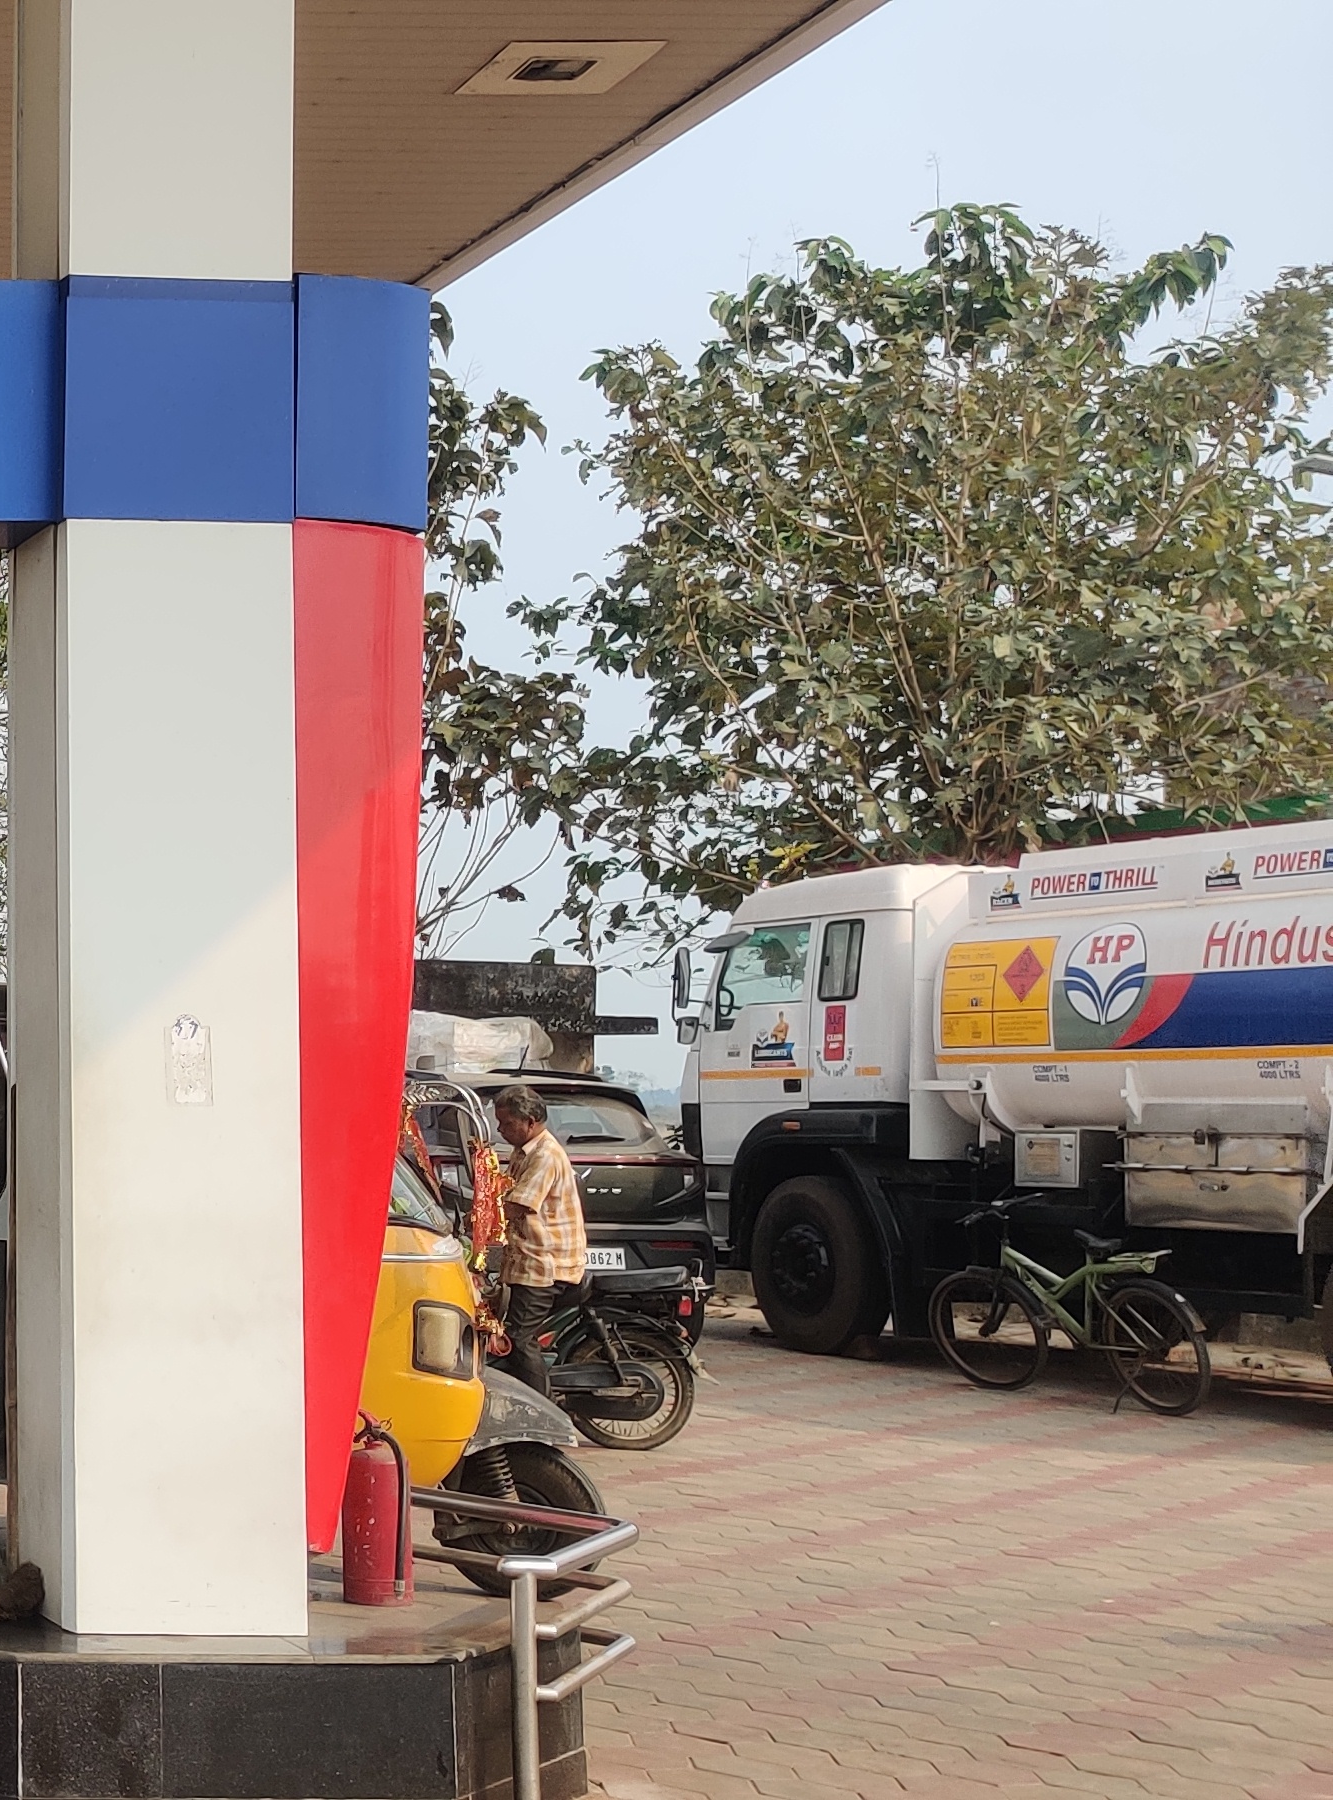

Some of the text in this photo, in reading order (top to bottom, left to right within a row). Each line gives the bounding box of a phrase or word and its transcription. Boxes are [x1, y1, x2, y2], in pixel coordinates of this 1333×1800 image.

[1253, 850, 1322, 876] POWER
[1031, 873, 1086, 895] POWER
[1104, 866, 1158, 889] THRILL
[1087, 935, 1136, 965] HP
[1257, 1060, 1286, 1069] COMPT
[1279, 1070, 1301, 1079] LTRS
